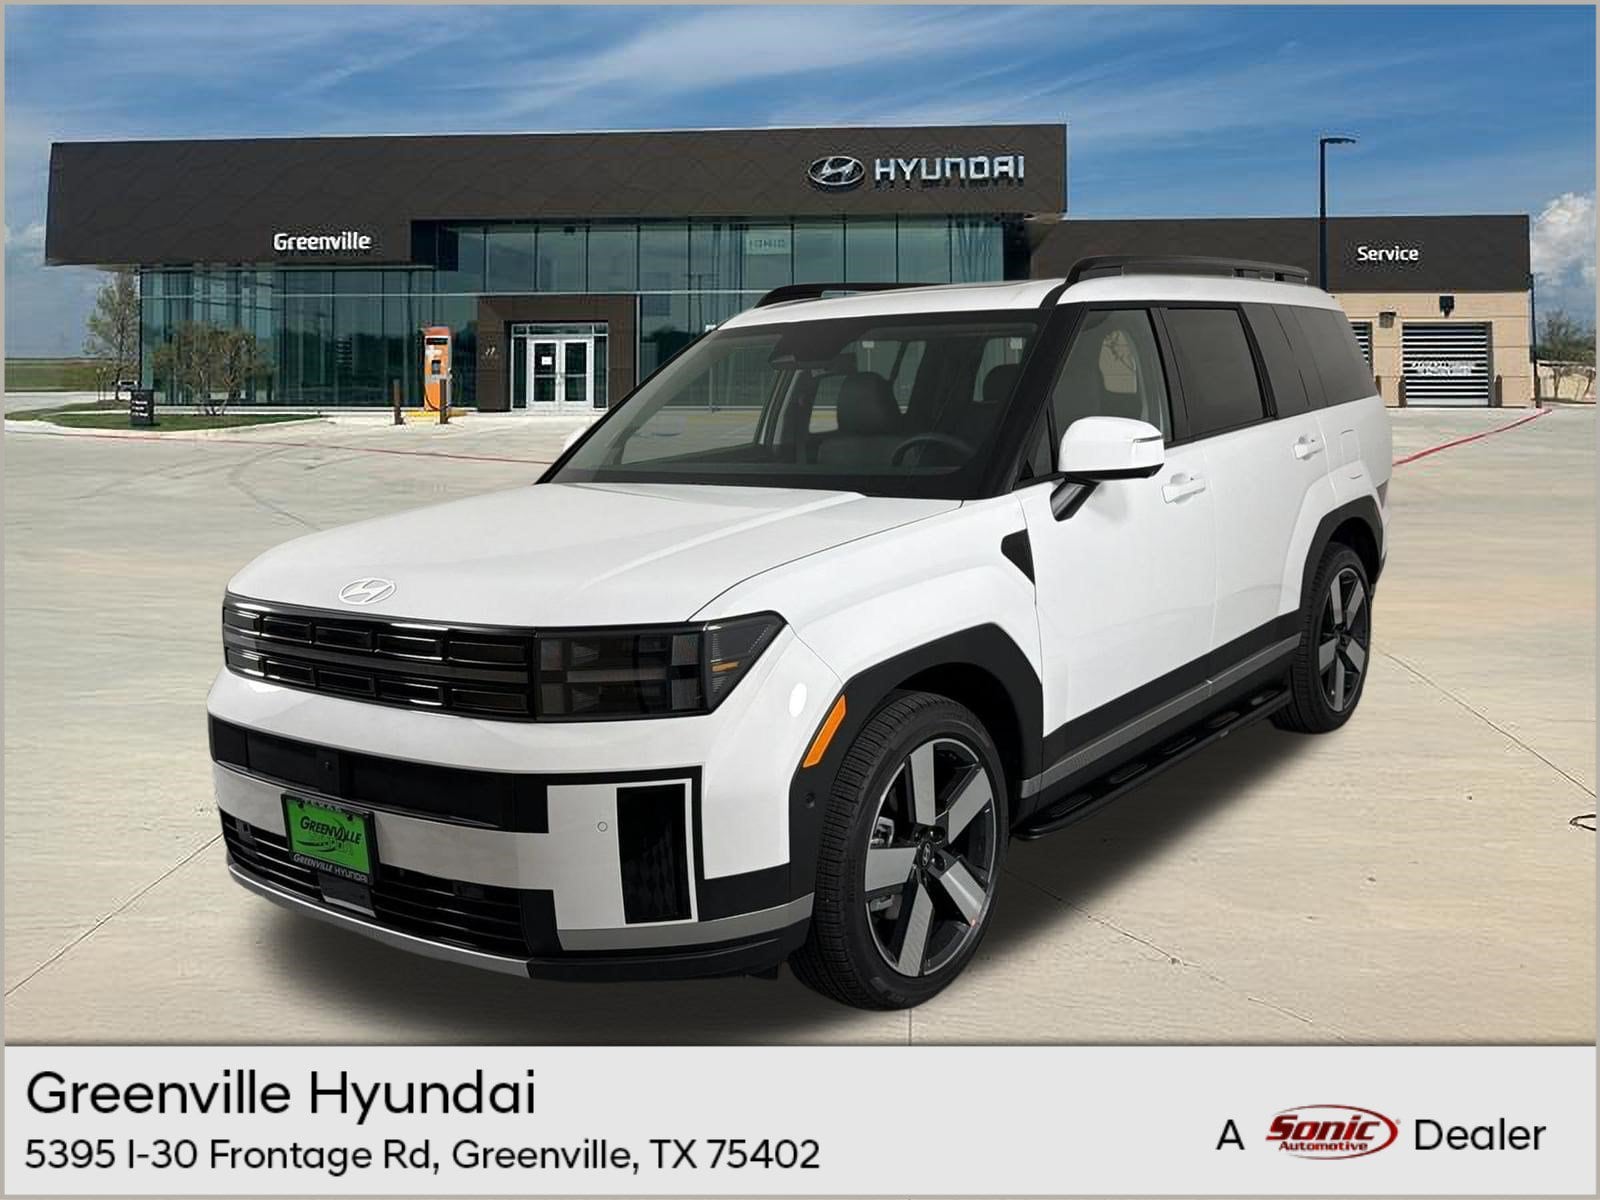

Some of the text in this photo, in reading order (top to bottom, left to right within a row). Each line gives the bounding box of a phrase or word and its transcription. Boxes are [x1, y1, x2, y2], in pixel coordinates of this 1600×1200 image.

[875, 154, 1025, 181] HYUNDAI
[272, 230, 373, 251] Greenville
[1356, 244, 1420, 262] Service
[300, 815, 362, 844] GREENVILLE
[293, 853, 333, 873] GREENVILLE
